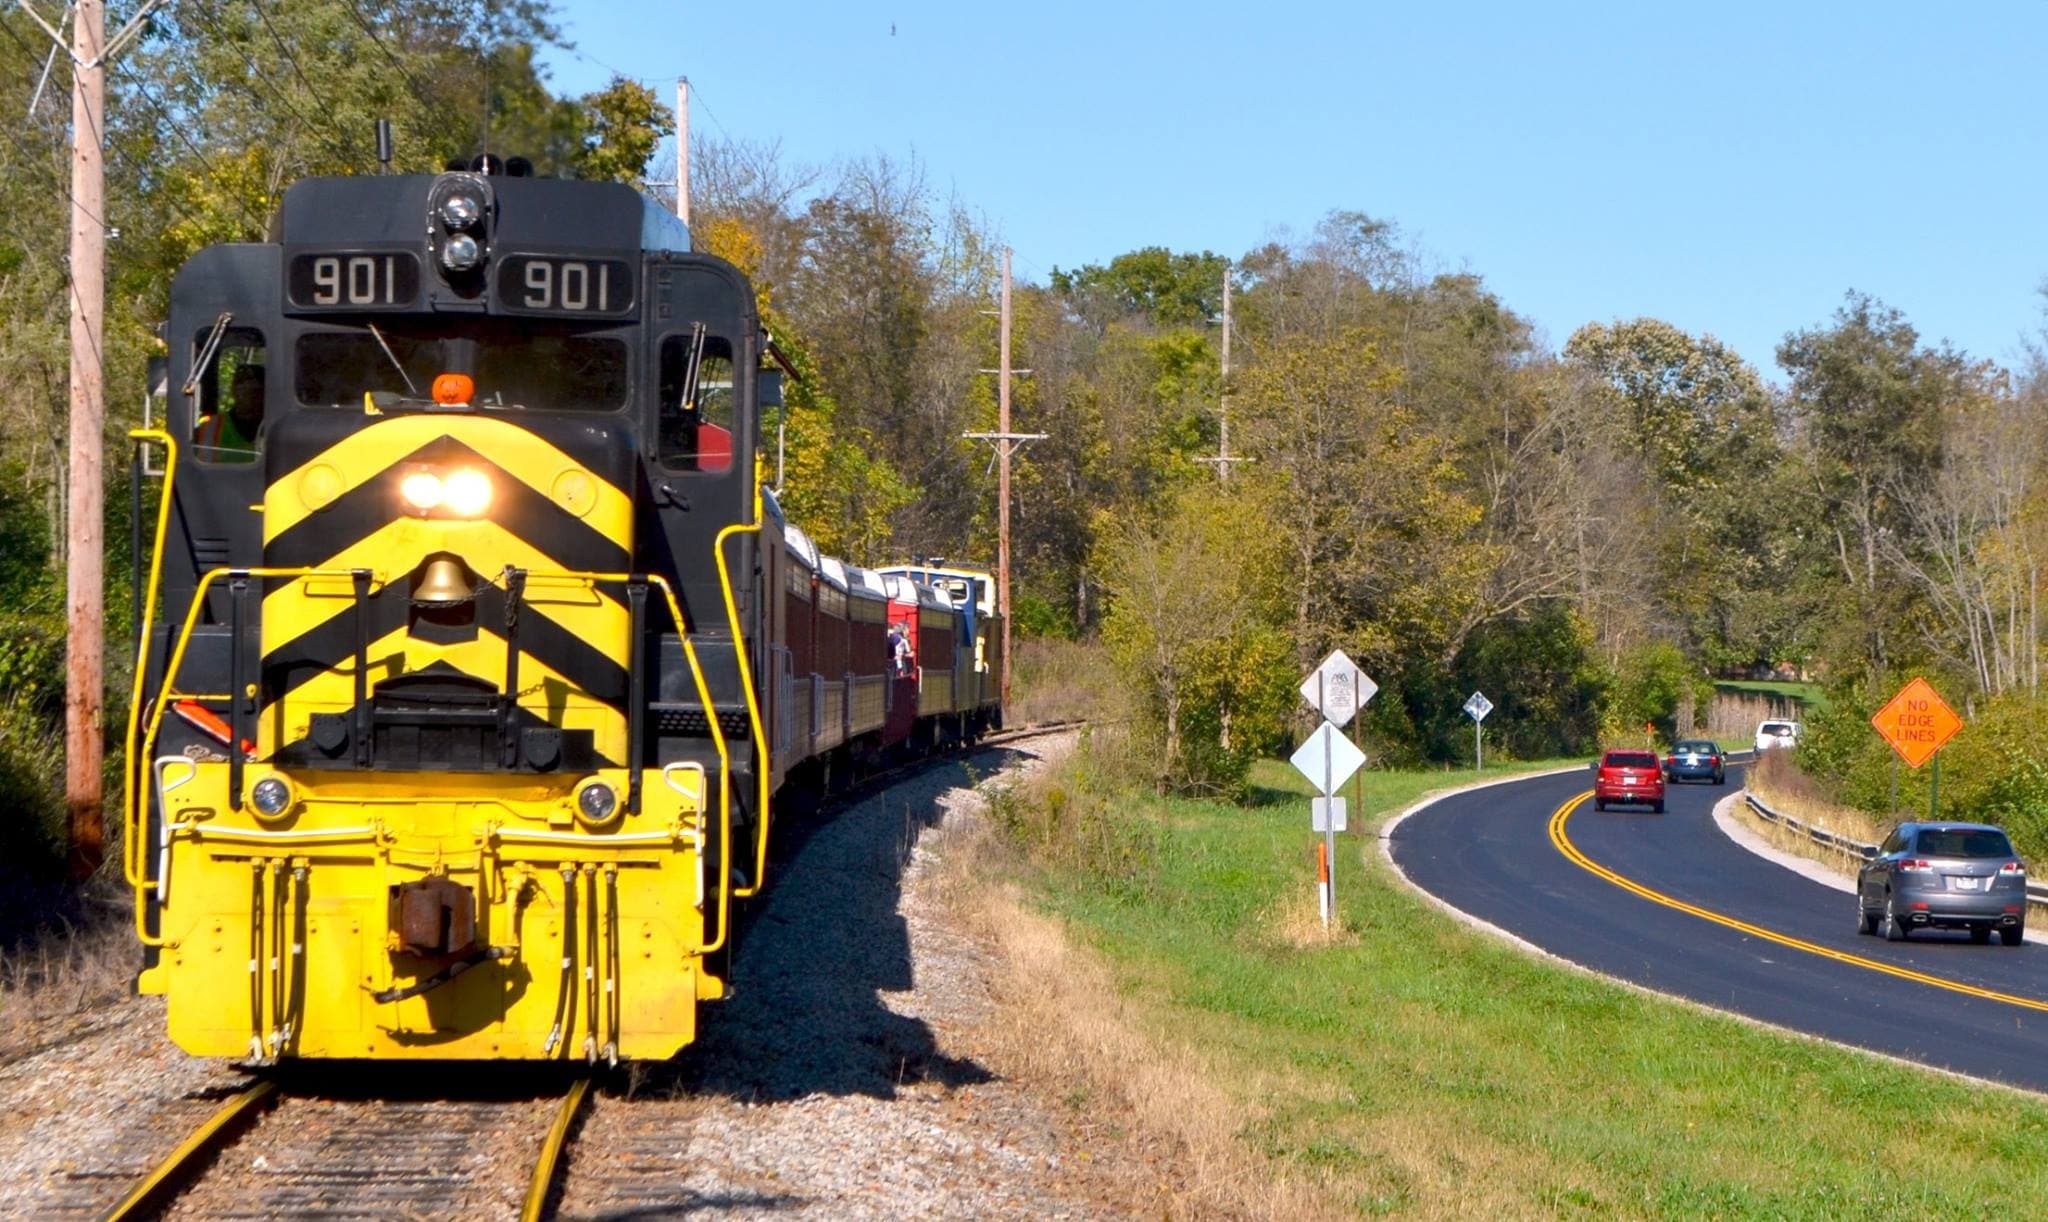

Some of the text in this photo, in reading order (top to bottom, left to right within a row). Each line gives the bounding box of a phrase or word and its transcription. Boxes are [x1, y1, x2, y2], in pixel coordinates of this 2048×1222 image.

[314, 256, 394, 304] 901
[524, 261, 607, 311] 901
[1908, 700, 1928, 712] NO
[1899, 714, 1935, 727] EDGE
[1896, 729, 1935, 742] LINES
